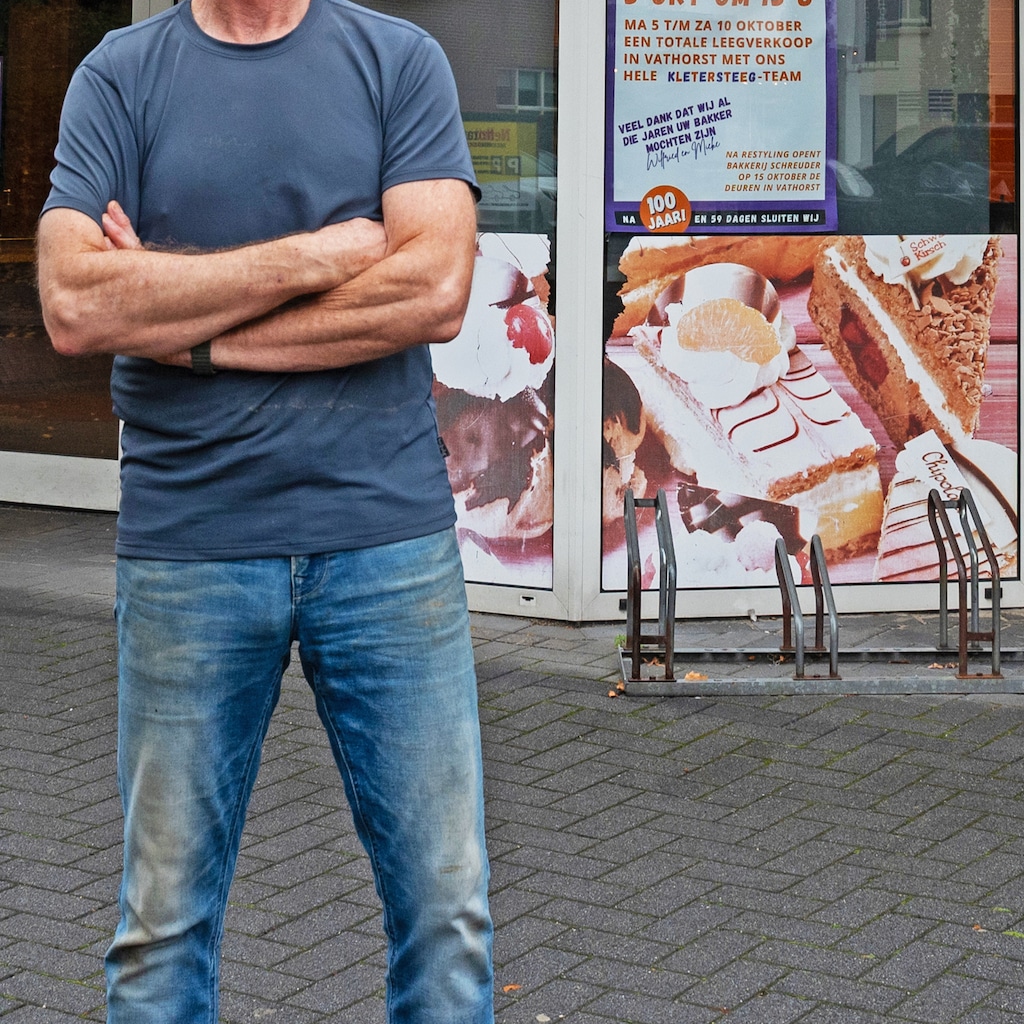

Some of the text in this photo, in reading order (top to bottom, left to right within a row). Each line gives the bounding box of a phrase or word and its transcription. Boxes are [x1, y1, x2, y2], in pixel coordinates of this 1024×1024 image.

[624, 19, 802, 32] MA 5 T/M ZA 10 OKTOBER
[624, 36, 813, 48] EEN TOTALE LEEGVERKOOP
[623, 53, 785, 65] IN VATHORST MET ONS
[623, 70, 802, 82] HELE KLETERSTEEG-TEAM
[618, 97, 731, 134] VEEL DANK DAT WIJ AL
[623, 109, 733, 146] DIE JAREN UW BAKKER
[646, 126, 716, 153] MOCHTEN ZIJN
[741, 150, 789, 158] RESTYLING
[792, 150, 821, 158] OPENT
[726, 162, 821, 171] BAKKERIJ SCHREUDER
[738, 173, 751, 181] OP
[724, 184, 760, 192] DEUREN
[776, 183, 821, 191] VATHORST
[646, 191, 676, 215] 100
[622, 215, 636, 224] NA
[648, 209, 686, 230] JAAR!
[694, 213, 819, 224] EN 59 DAGEN SLUITEN WIJ
[914, 241, 946, 261] Kirsch
[922, 451, 965, 501] Chipola
